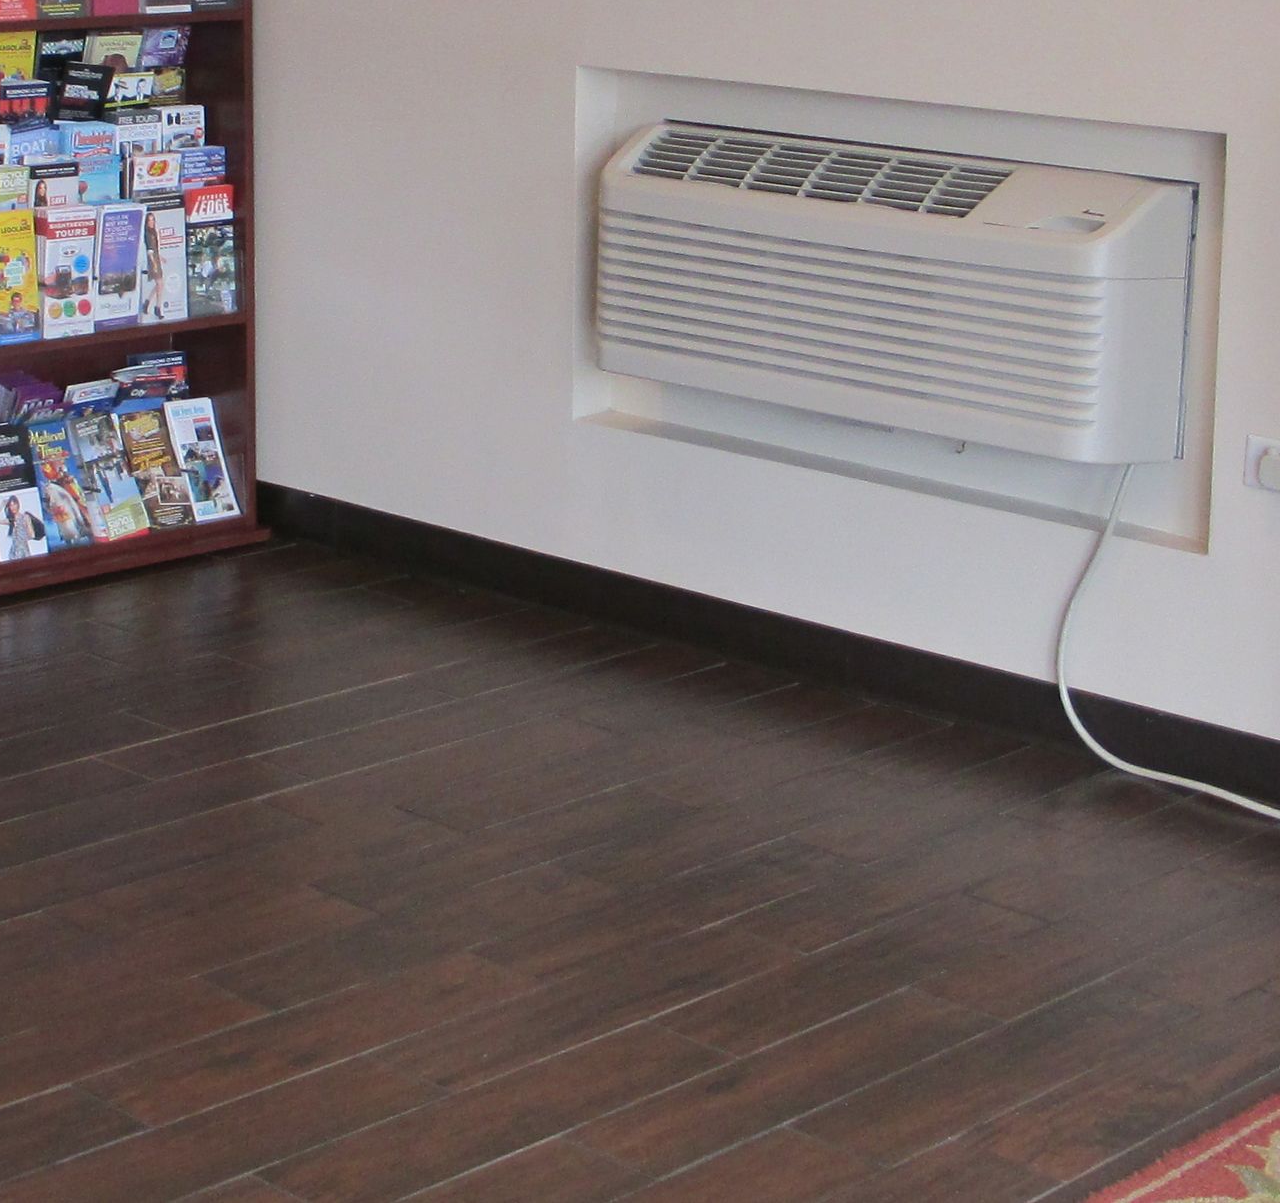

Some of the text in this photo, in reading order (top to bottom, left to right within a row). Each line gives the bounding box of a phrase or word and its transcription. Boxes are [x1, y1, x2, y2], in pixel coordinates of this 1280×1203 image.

[118, 115, 135, 125] FREE
[0, 178, 28, 189] TOURS
[55, 227, 88, 238] TOURS
[20, 399, 55, 416] MAP
